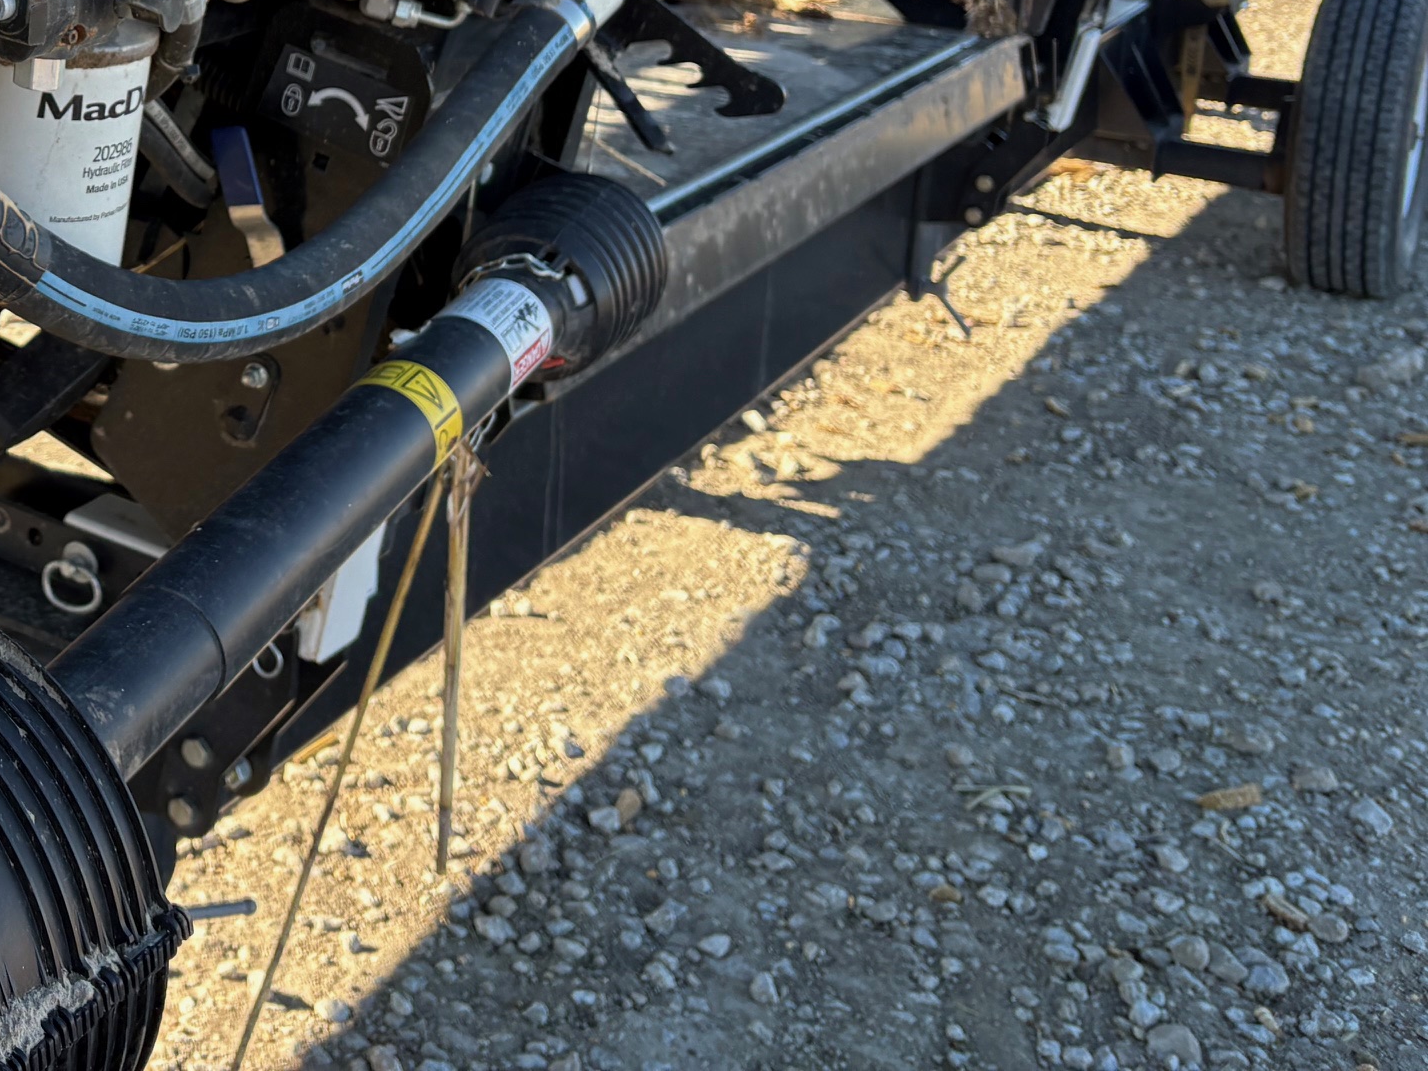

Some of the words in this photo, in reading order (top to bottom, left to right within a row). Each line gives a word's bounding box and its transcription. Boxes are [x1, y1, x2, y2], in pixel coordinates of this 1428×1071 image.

[37, 86, 145, 122] MacD
[92, 137, 134, 163] 202986
[82, 163, 120, 180] Hydraulic
[86, 183, 109, 194] Made
[110, 181, 117, 190] in
[49, 214, 93, 223] Manufactured
[93, 213, 100, 221] by
[177, 327, 197, 339] PSI)
